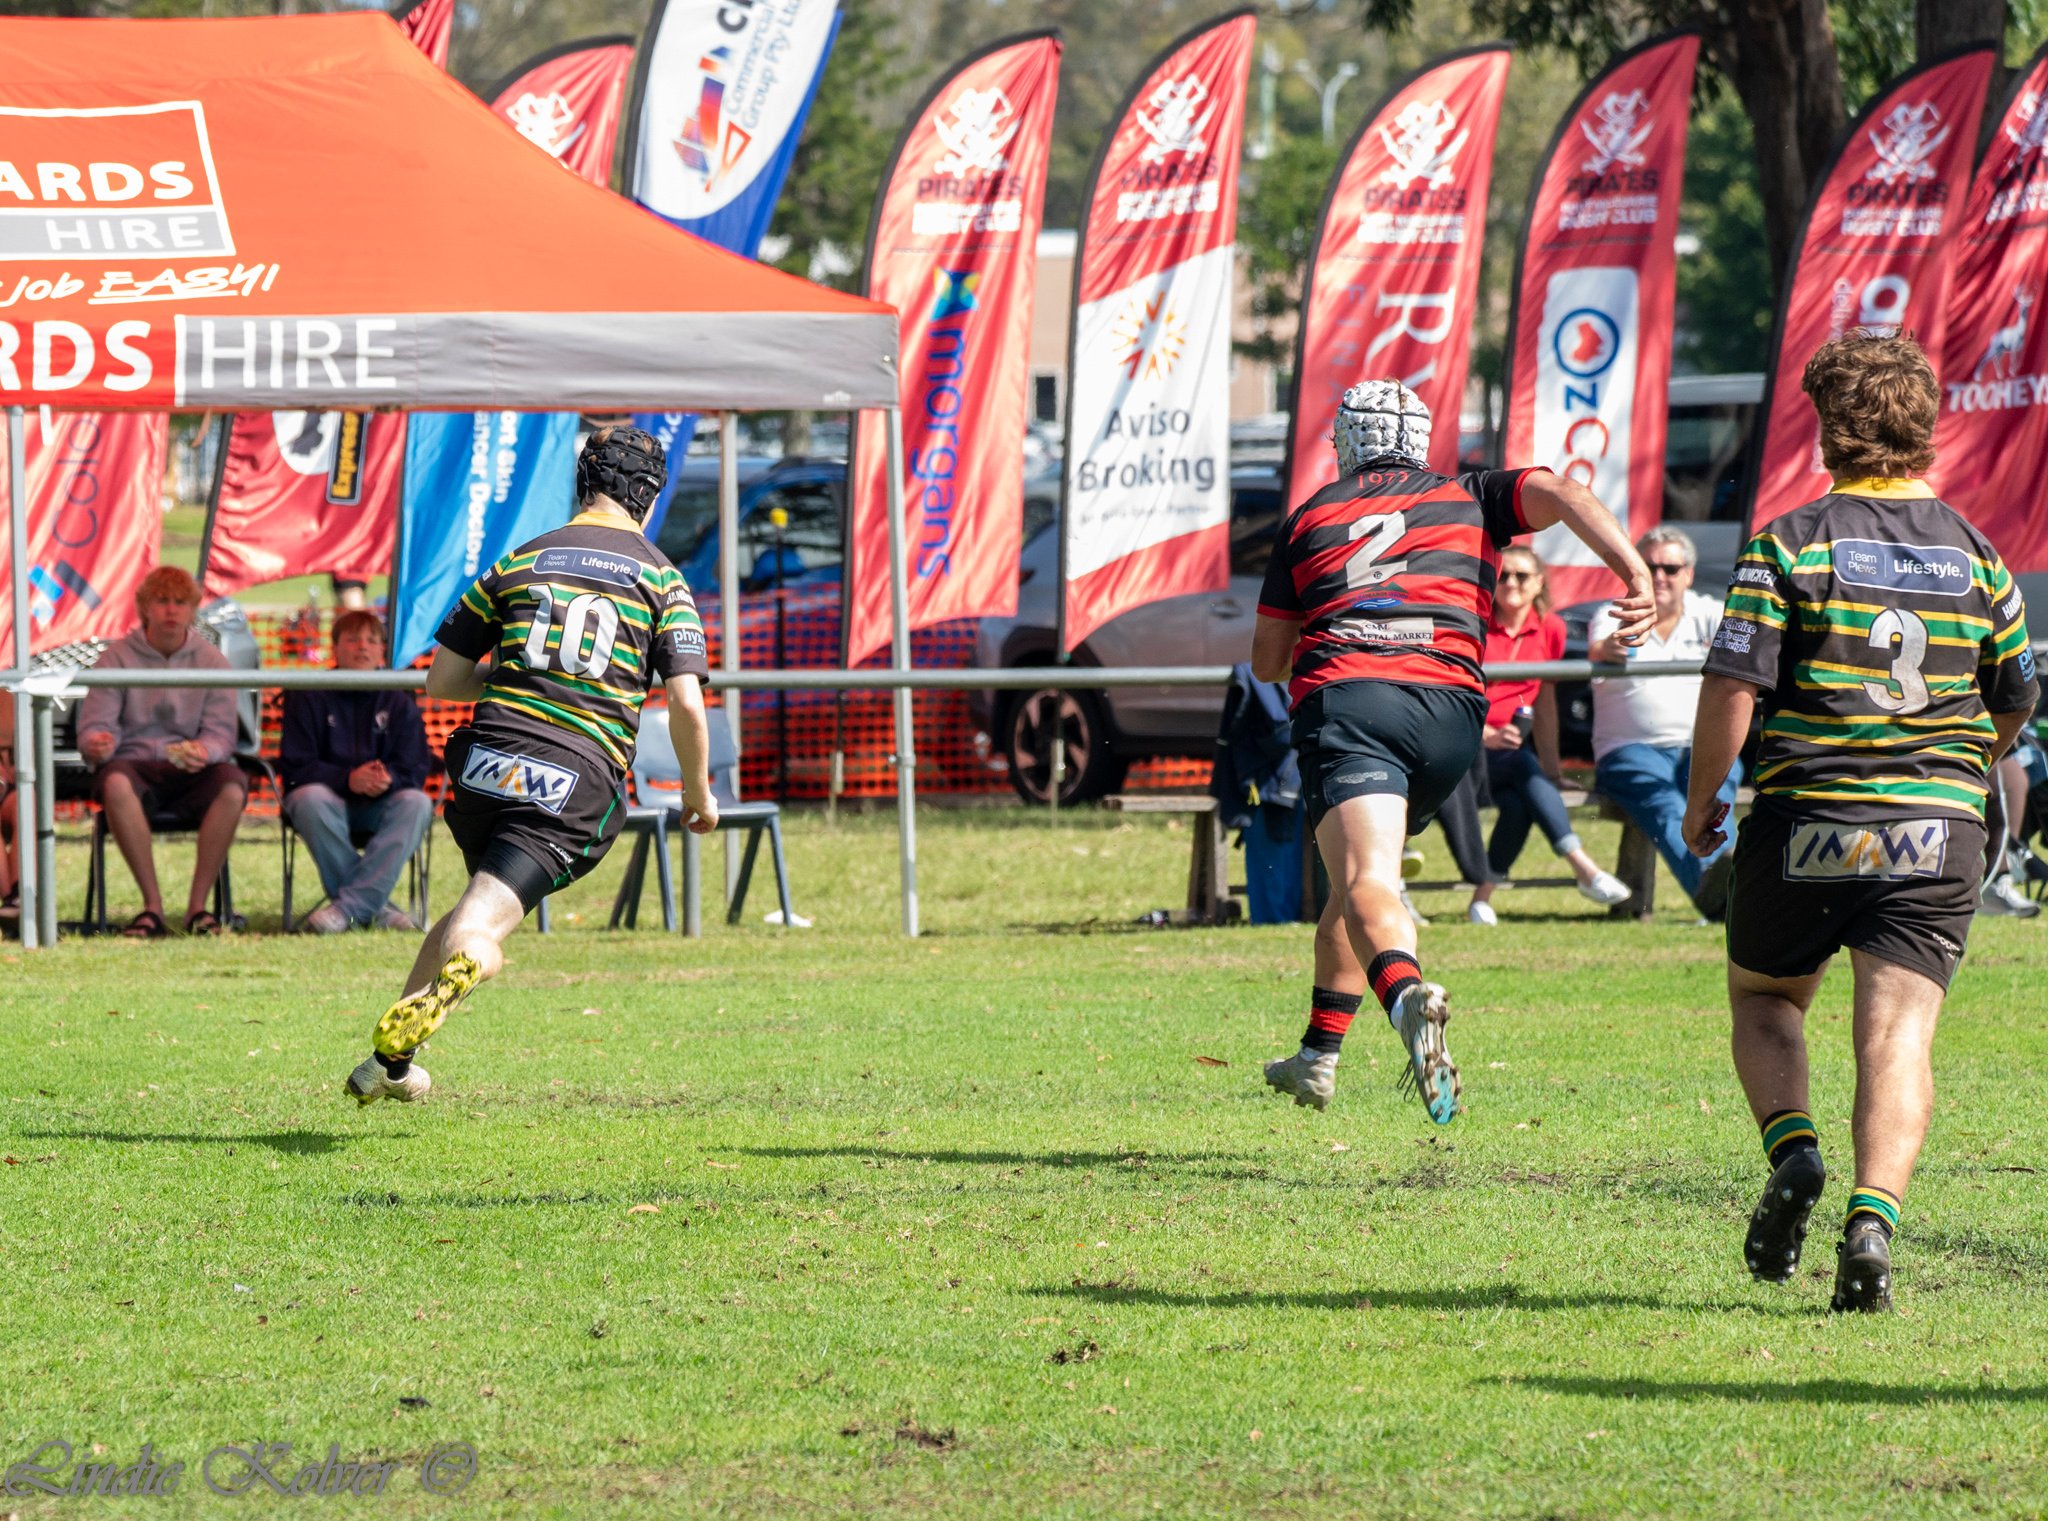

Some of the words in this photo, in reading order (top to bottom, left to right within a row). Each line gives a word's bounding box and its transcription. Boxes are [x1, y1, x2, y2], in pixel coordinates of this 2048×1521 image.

[725, 3, 776, 116] Commercial
[741, 66, 779, 129] Group
[762, 29, 791, 65] Pty
[45, 215, 205, 251] HIRE
[201, 319, 397, 389] HIRE
[1104, 402, 1191, 441] Aviso
[910, 328, 967, 579] morgans
[1077, 448, 1216, 493] Broking
[464, 482, 491, 577] Doctors
[1345, 510, 1408, 590] 2
[581, 556, 634, 576] Lifestyle.
[1847, 561, 1877, 575] Plews
[1848, 550, 1877, 563] Team
[1893, 559, 1964, 579] Lifestyle.
[519, 583, 620, 680] 10
[1392, 632, 1434, 641] MARKET
[1724, 617, 1758, 635] Choice
[1732, 633, 1751, 644] and
[1860, 608, 1930, 715] 3
